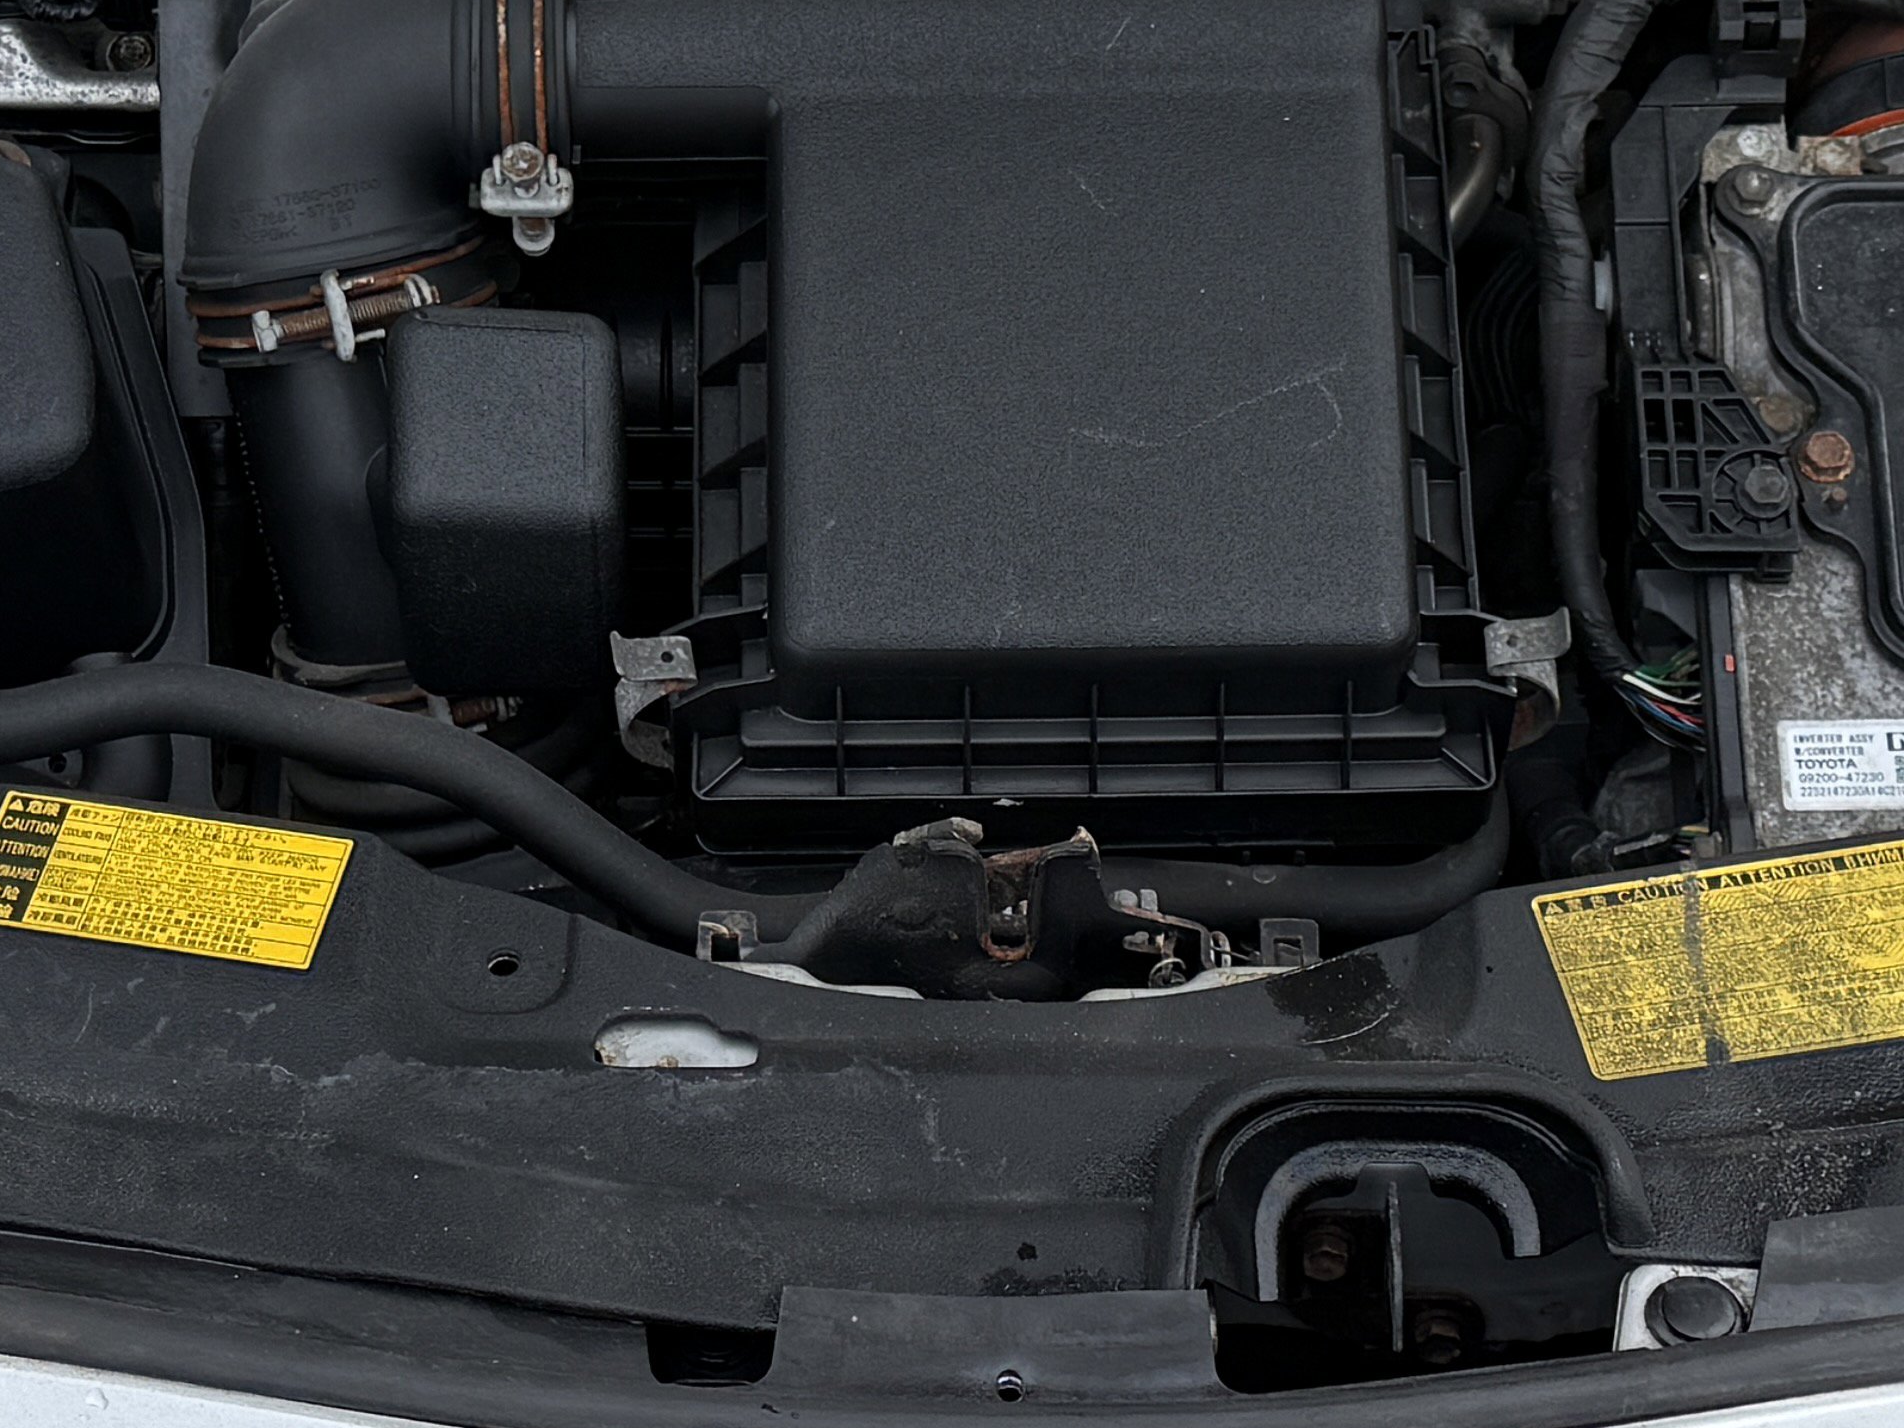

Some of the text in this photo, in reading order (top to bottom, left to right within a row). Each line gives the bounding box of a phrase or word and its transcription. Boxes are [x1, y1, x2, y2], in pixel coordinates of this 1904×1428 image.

[1794, 734, 1874, 743] INVERTER ASSY
[1795, 746, 1864, 756] W/CONVERTER
[1795, 758, 1857, 770] TOYOTA
[1, 816, 60, 837] CAUTION
[1618, 877, 1709, 905] CAUTION
[1720, 858, 1836, 889] ATTENTION
